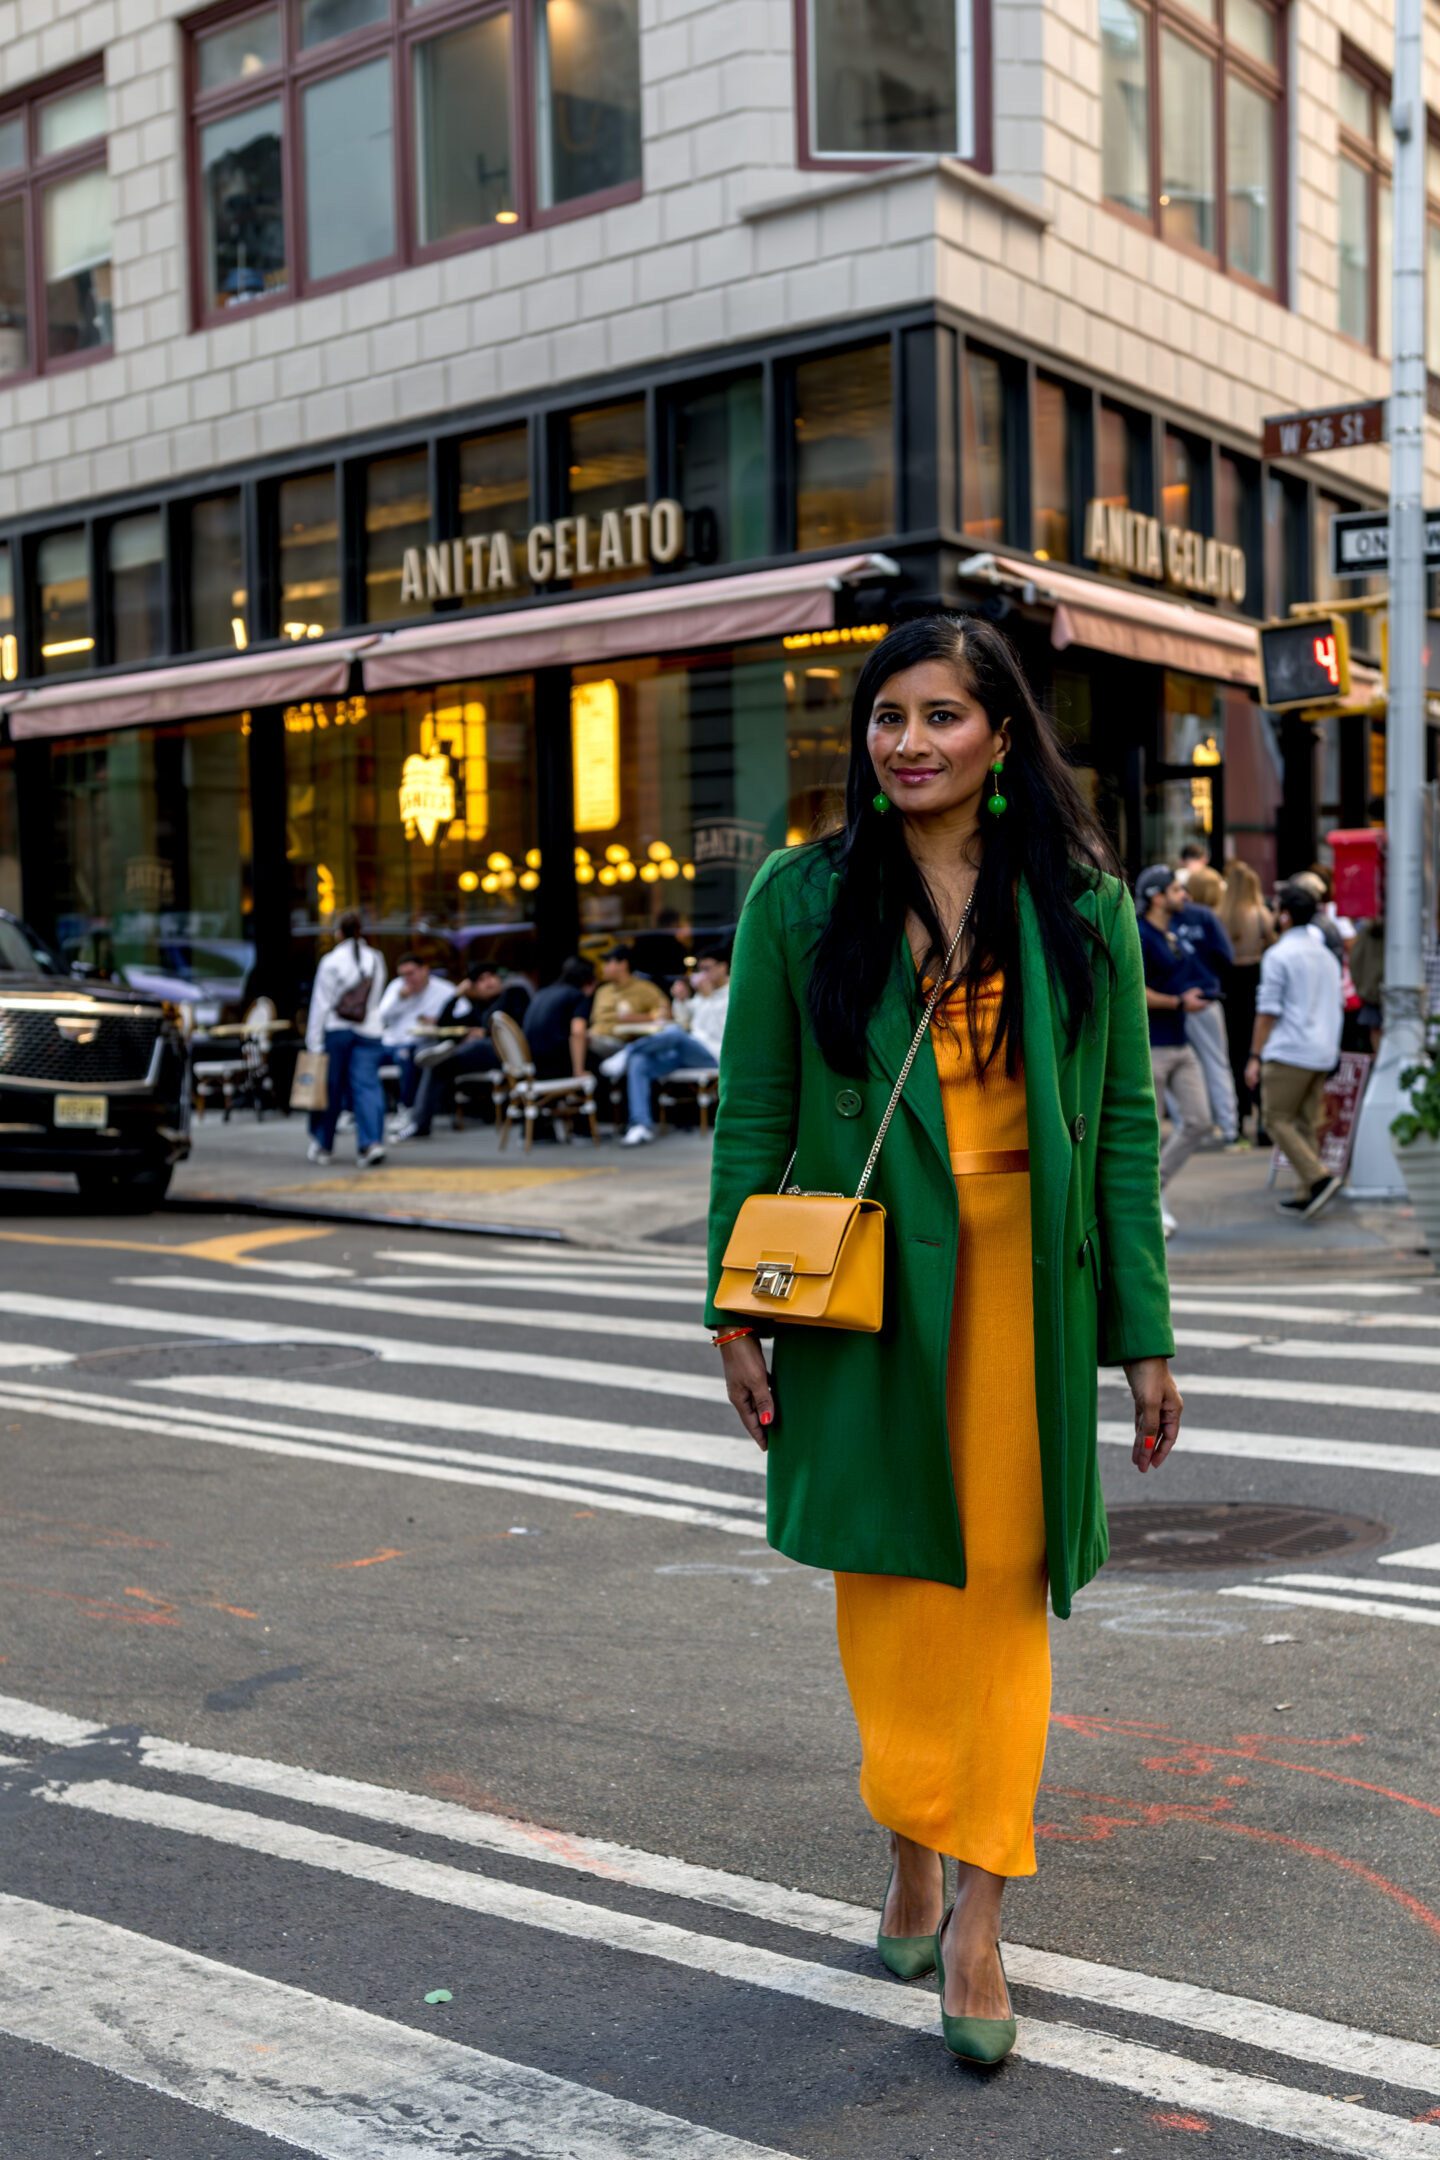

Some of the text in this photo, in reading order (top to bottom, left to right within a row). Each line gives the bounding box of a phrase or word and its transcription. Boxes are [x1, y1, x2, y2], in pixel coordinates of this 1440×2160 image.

[1279, 412, 1365, 455] W 26 St
[401, 498, 684, 602] ANITA GELATO
[1084, 499, 1246, 605] ANITA GELATO
[1356, 532, 1389, 555] ON
[1313, 634, 1340, 685] 4
